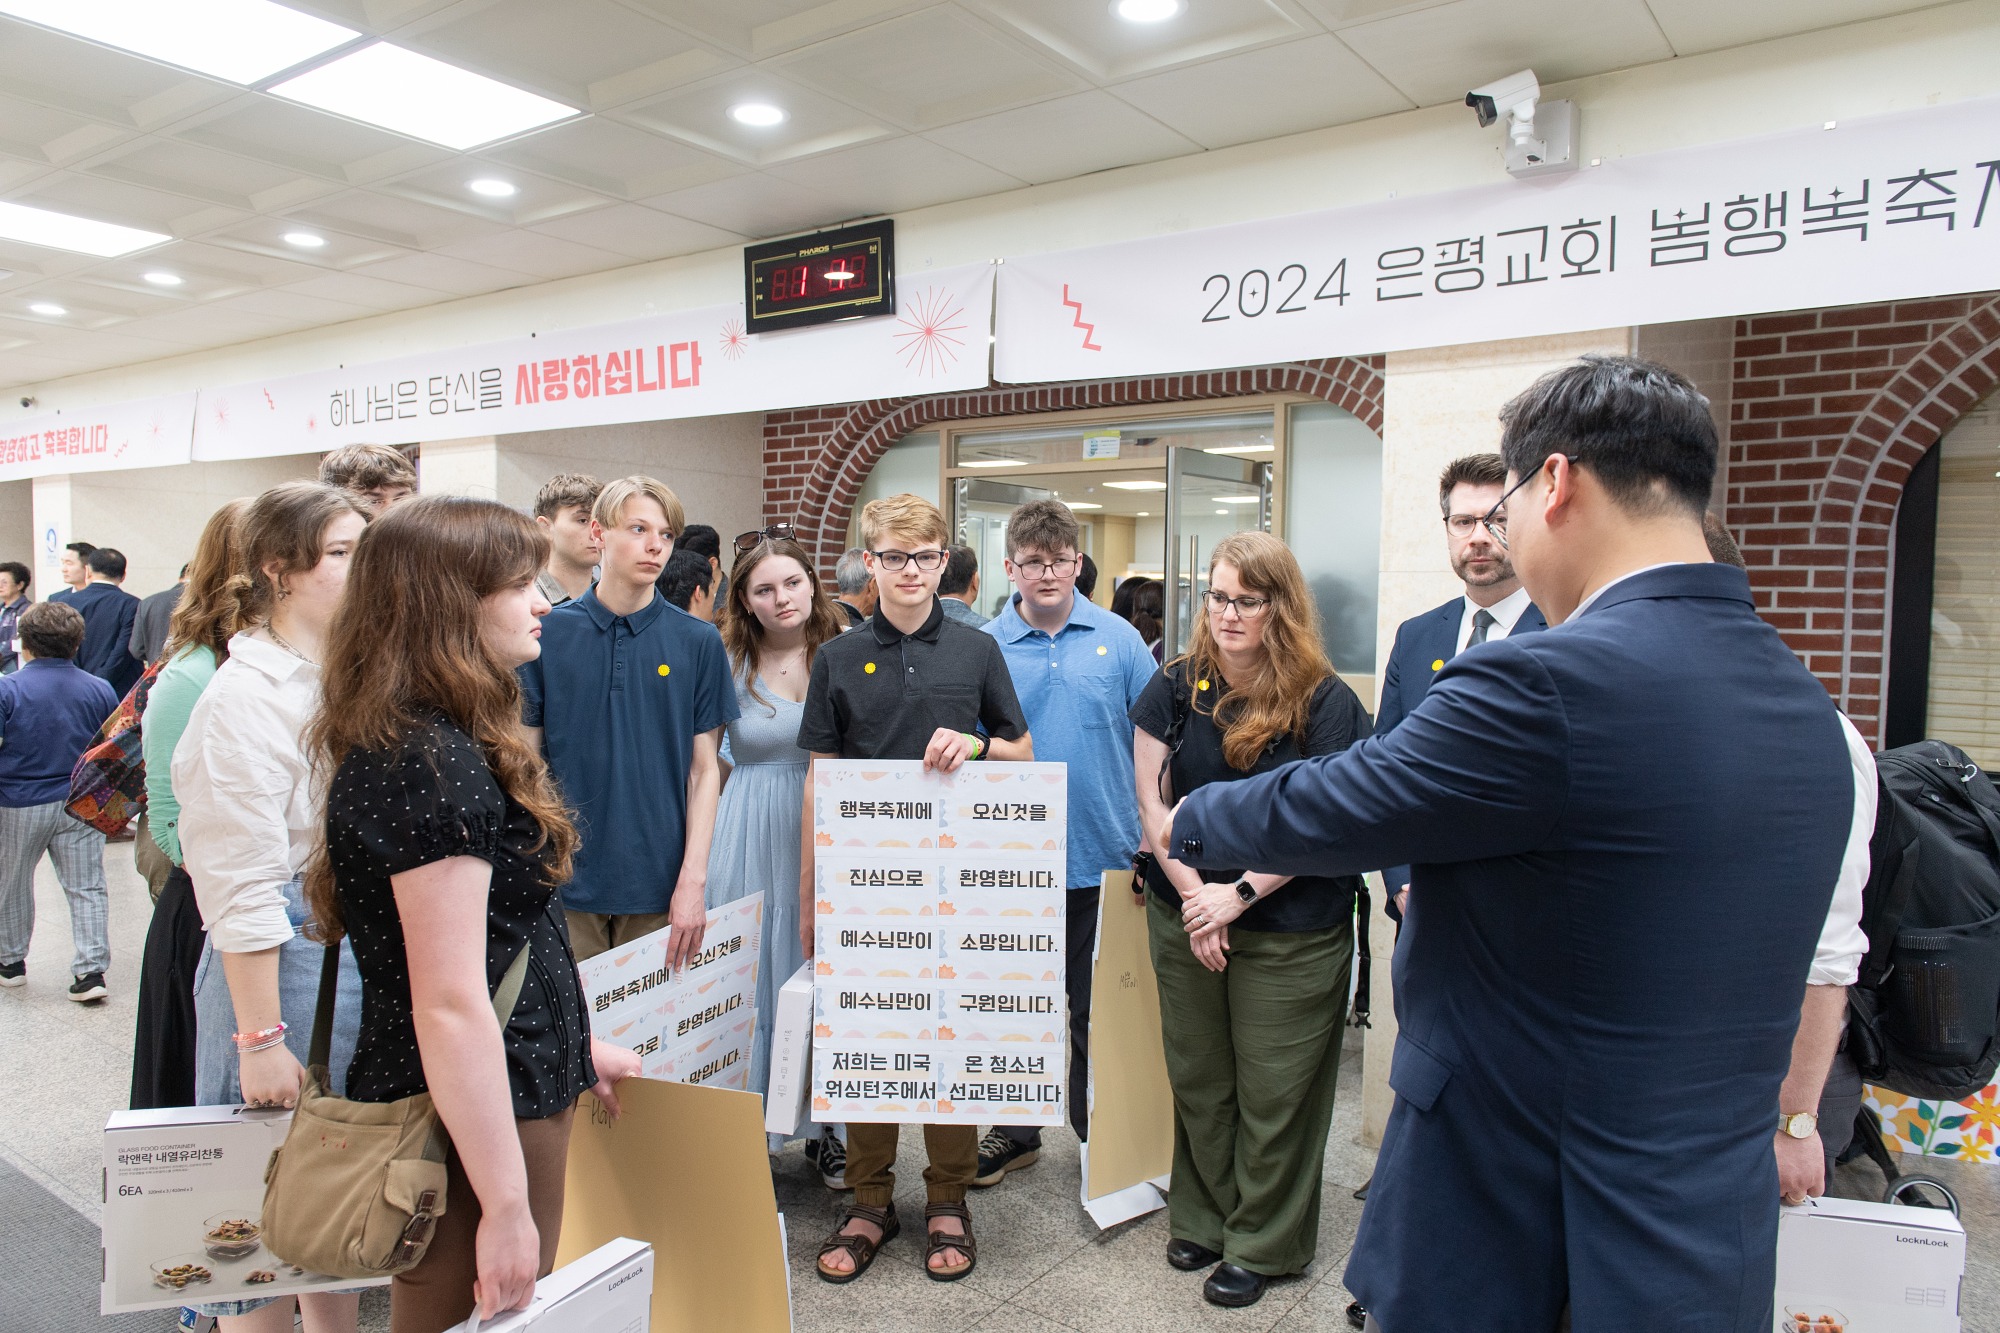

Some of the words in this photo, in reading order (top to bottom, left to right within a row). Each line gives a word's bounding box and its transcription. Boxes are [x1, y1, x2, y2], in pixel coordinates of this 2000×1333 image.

[799, 244, 830, 258] PHAROS
[1201, 257, 1351, 323] 2024
[1375, 214, 1617, 302] 은평교회
[329, 380, 418, 427] 하나님은
[428, 367, 502, 416] 당신을
[514, 340, 702, 405] 사랑하십니다
[44, 423, 108, 456] 축복합니다
[839, 800, 933, 820] 행복축제에
[972, 803, 1048, 822] 오신것을
[849, 868, 924, 888] 진심으로
[959, 868, 1058, 889] 환영합니다.
[840, 929, 932, 950] 예수님만이
[959, 933, 1058, 953] 소망입니다.
[689, 935, 742, 971] 오신것을
[595, 966, 670, 1013] 행복축제에
[839, 991, 931, 1011] 예수님만이
[958, 993, 1058, 1014] 구원입니다.
[677, 992, 744, 1037] 환영합니다.
[682, 1048, 741, 1084] 망입니다.
[832, 1051, 888, 1072] 저희는
[894, 1053, 931, 1072] 미국
[964, 1055, 984, 1074] 온
[989, 1054, 1045, 1075] 청소년
[824, 1079, 936, 1100] 워싱턴주에서
[949, 1082, 1062, 1103] 선교팀입니다
[117, 1152, 152, 1166] 락앤락
[155, 1147, 224, 1163] 내열유리찬통
[160, 1143, 196, 1151] CONTAINER
[118, 1184, 143, 1197] 6EA
[1895, 1234, 1949, 1248] LocknLock
[608, 1266, 644, 1292] LocknLock
